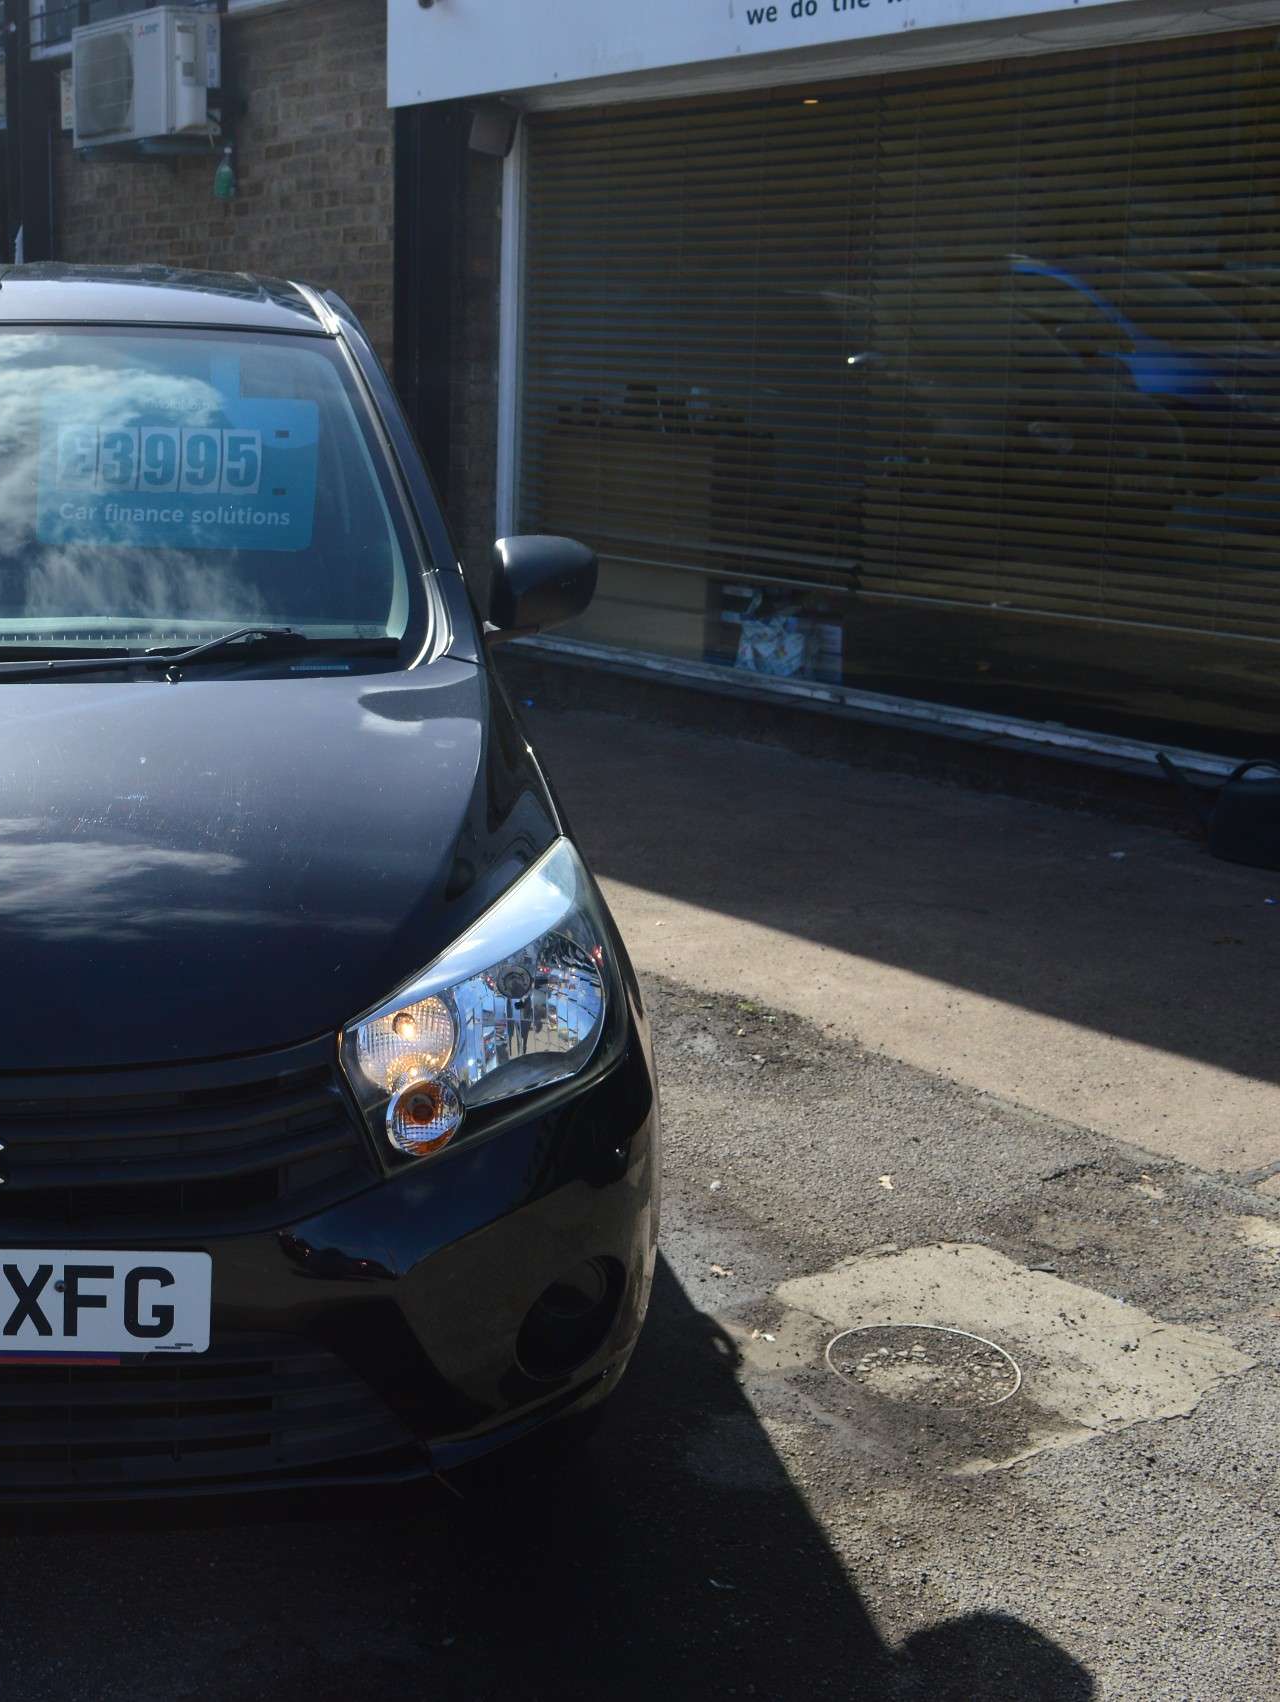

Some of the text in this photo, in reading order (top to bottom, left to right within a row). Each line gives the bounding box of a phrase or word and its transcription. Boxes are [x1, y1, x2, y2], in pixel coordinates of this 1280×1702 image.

[747, 6, 778, 25] we
[790, 0, 818, 18] do
[59, 502, 291, 526] Car finance solutions
[2, 1263, 176, 1339] XFG
